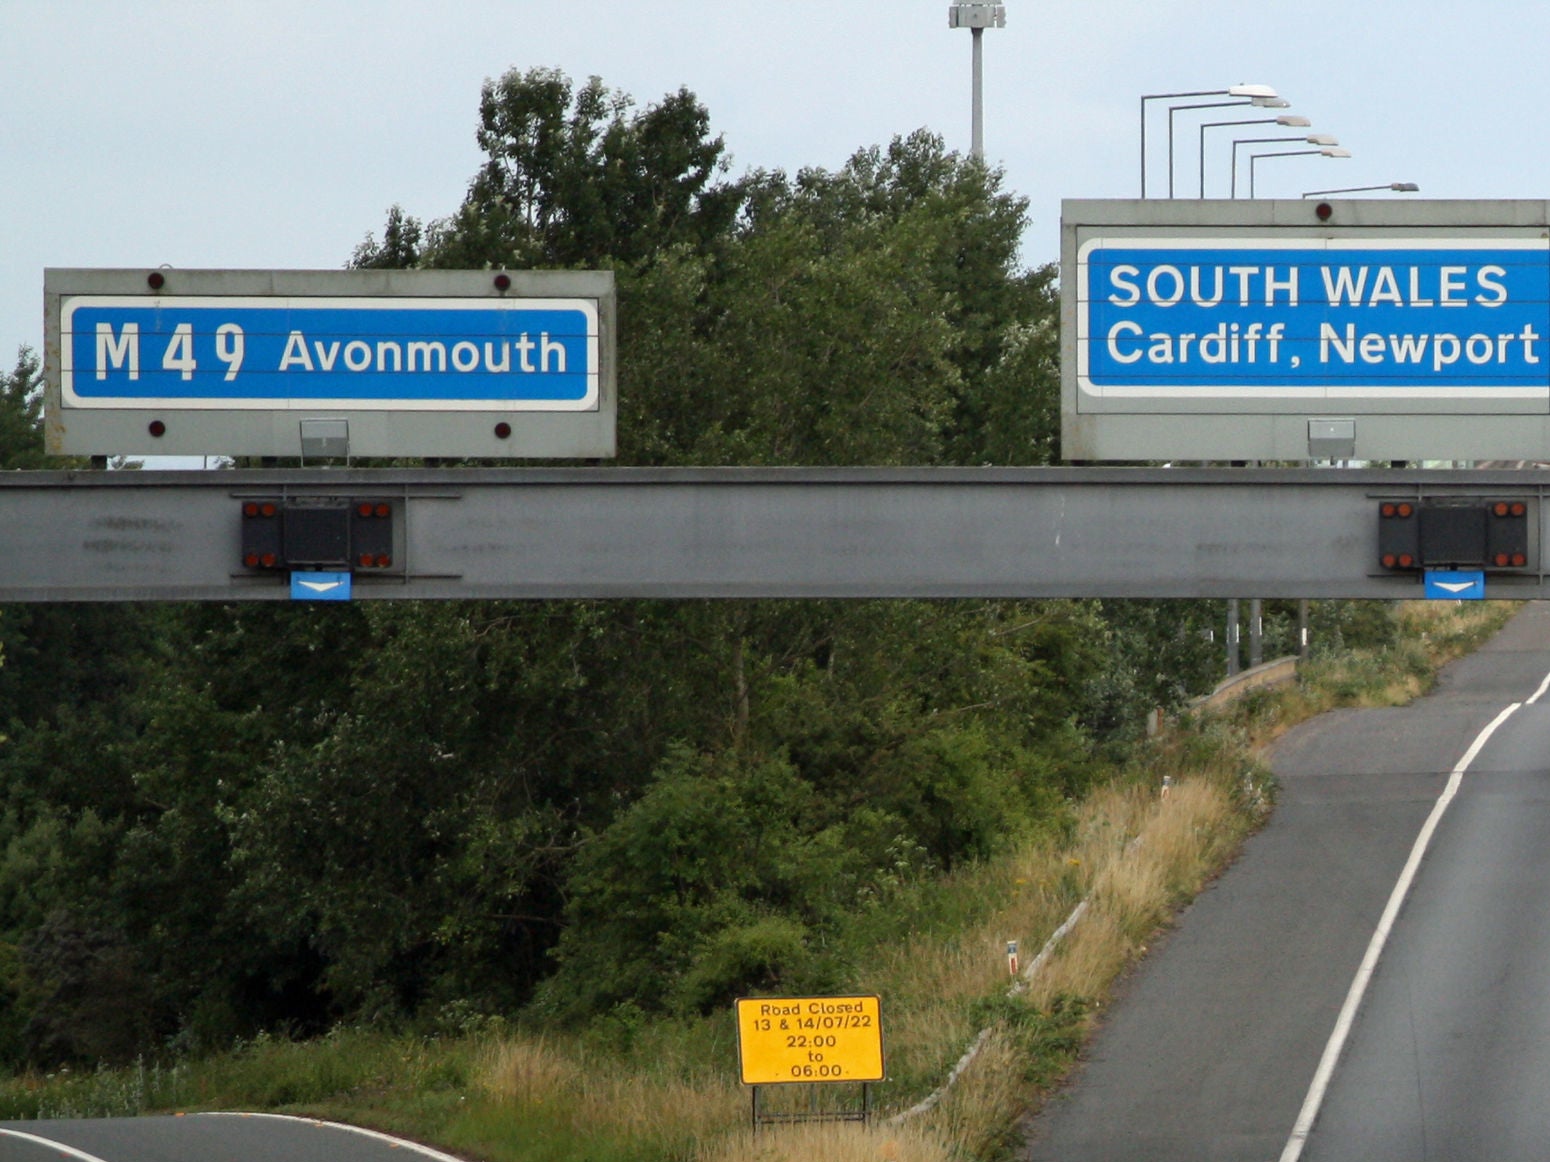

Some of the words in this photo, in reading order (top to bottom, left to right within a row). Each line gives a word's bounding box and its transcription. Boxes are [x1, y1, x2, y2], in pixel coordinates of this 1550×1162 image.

[1109, 265, 1297, 307] SOUTH
[1321, 265, 1507, 307] WALES
[280, 331, 566, 372] Avonmouth
[1108, 321, 1299, 368] Cardiff,
[1320, 323, 1539, 371] Newport
[761, 1004, 800, 1016] Road
[809, 1001, 863, 1014] Closed
[754, 1020, 771, 1031] 13
[780, 1019, 789, 1030] &
[797, 1015, 871, 1030] 14/07/22
[787, 1035, 836, 1047] 22:00
[808, 1051, 823, 1062] to
[791, 1065, 841, 1077] 06:00
